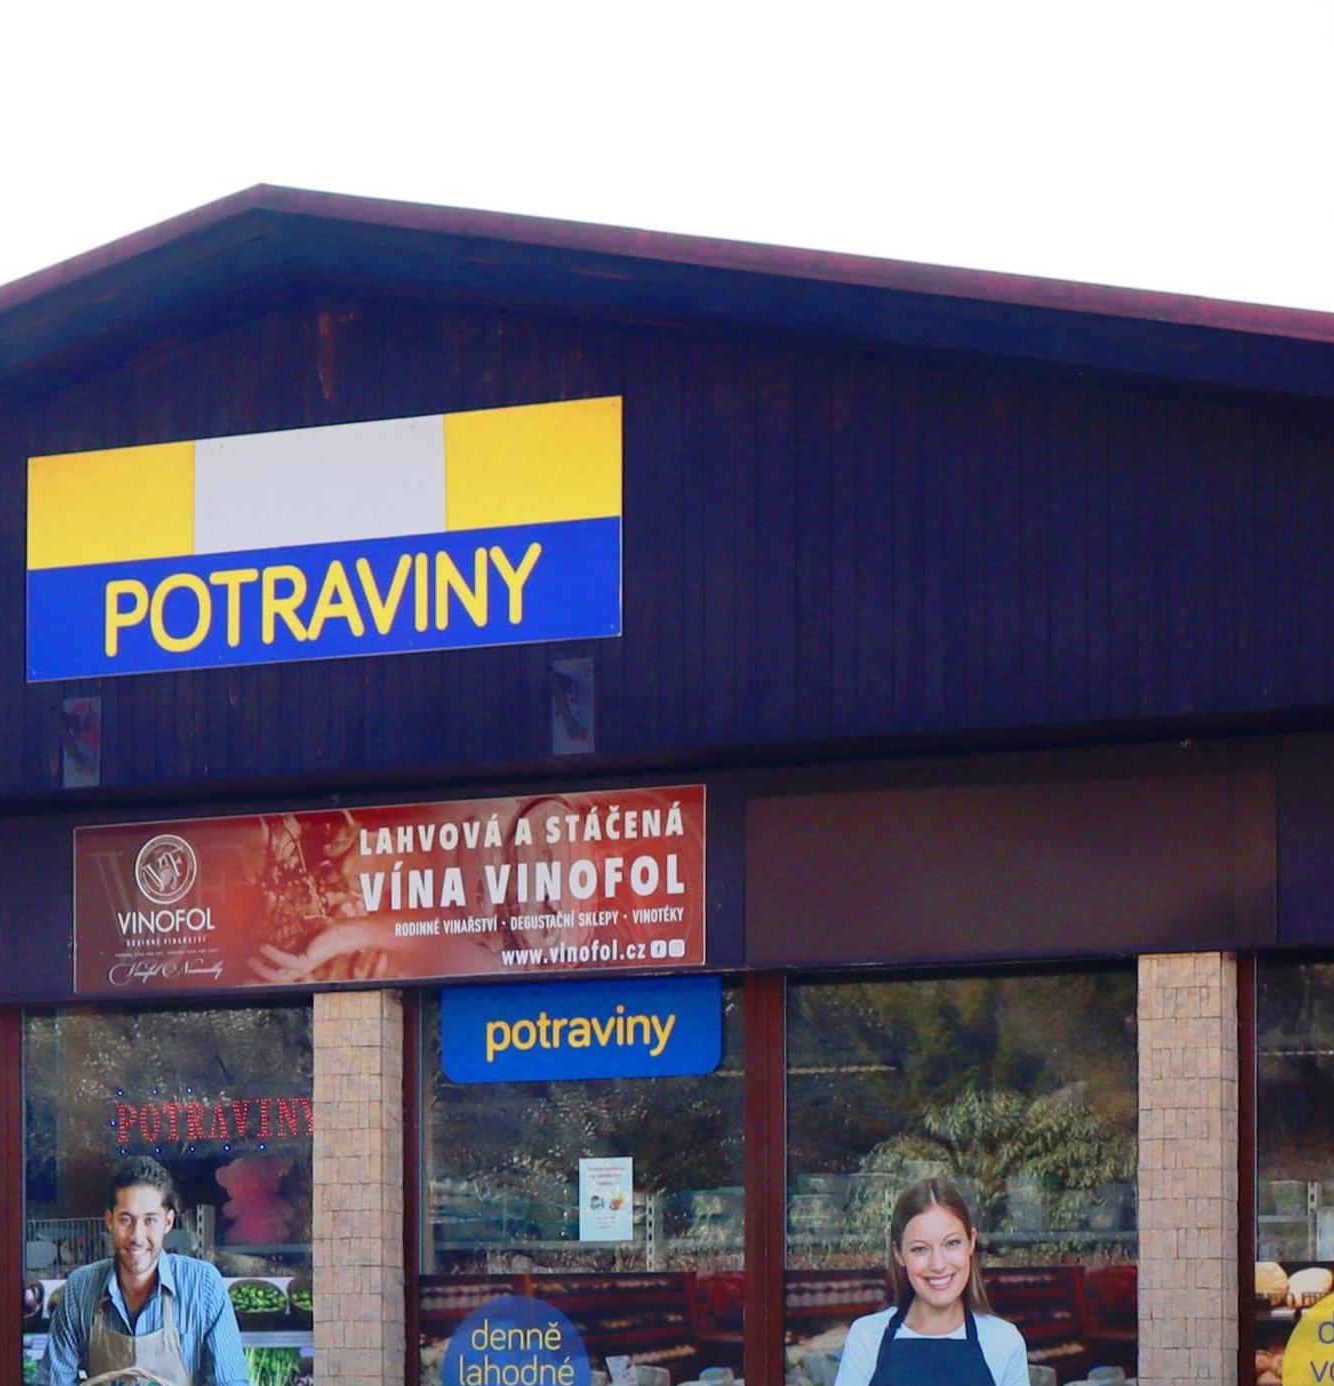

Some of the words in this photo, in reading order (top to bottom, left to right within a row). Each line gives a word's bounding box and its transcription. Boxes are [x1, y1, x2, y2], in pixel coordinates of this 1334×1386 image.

[104, 542, 542, 657] POTRAVINY
[359, 813, 503, 856] LAHVOVÁ
[514, 817, 533, 846] A
[545, 800, 685, 844] STÁČENÁ
[359, 861, 467, 912] VÍNA
[484, 853, 685, 904] VINOFOL
[117, 907, 216, 936] VINOFOL
[395, 918, 440, 937] RODINNÉ
[444, 914, 498, 934] VINAŘSTVÍ
[510, 909, 575, 931] DEGUSTAČNÍ
[578, 910, 619, 928] SKLEPY
[502, 939, 646, 966] www.vinofol.cz
[485, 1004, 677, 1061] potraviny
[471, 1320, 563, 1351] denně
